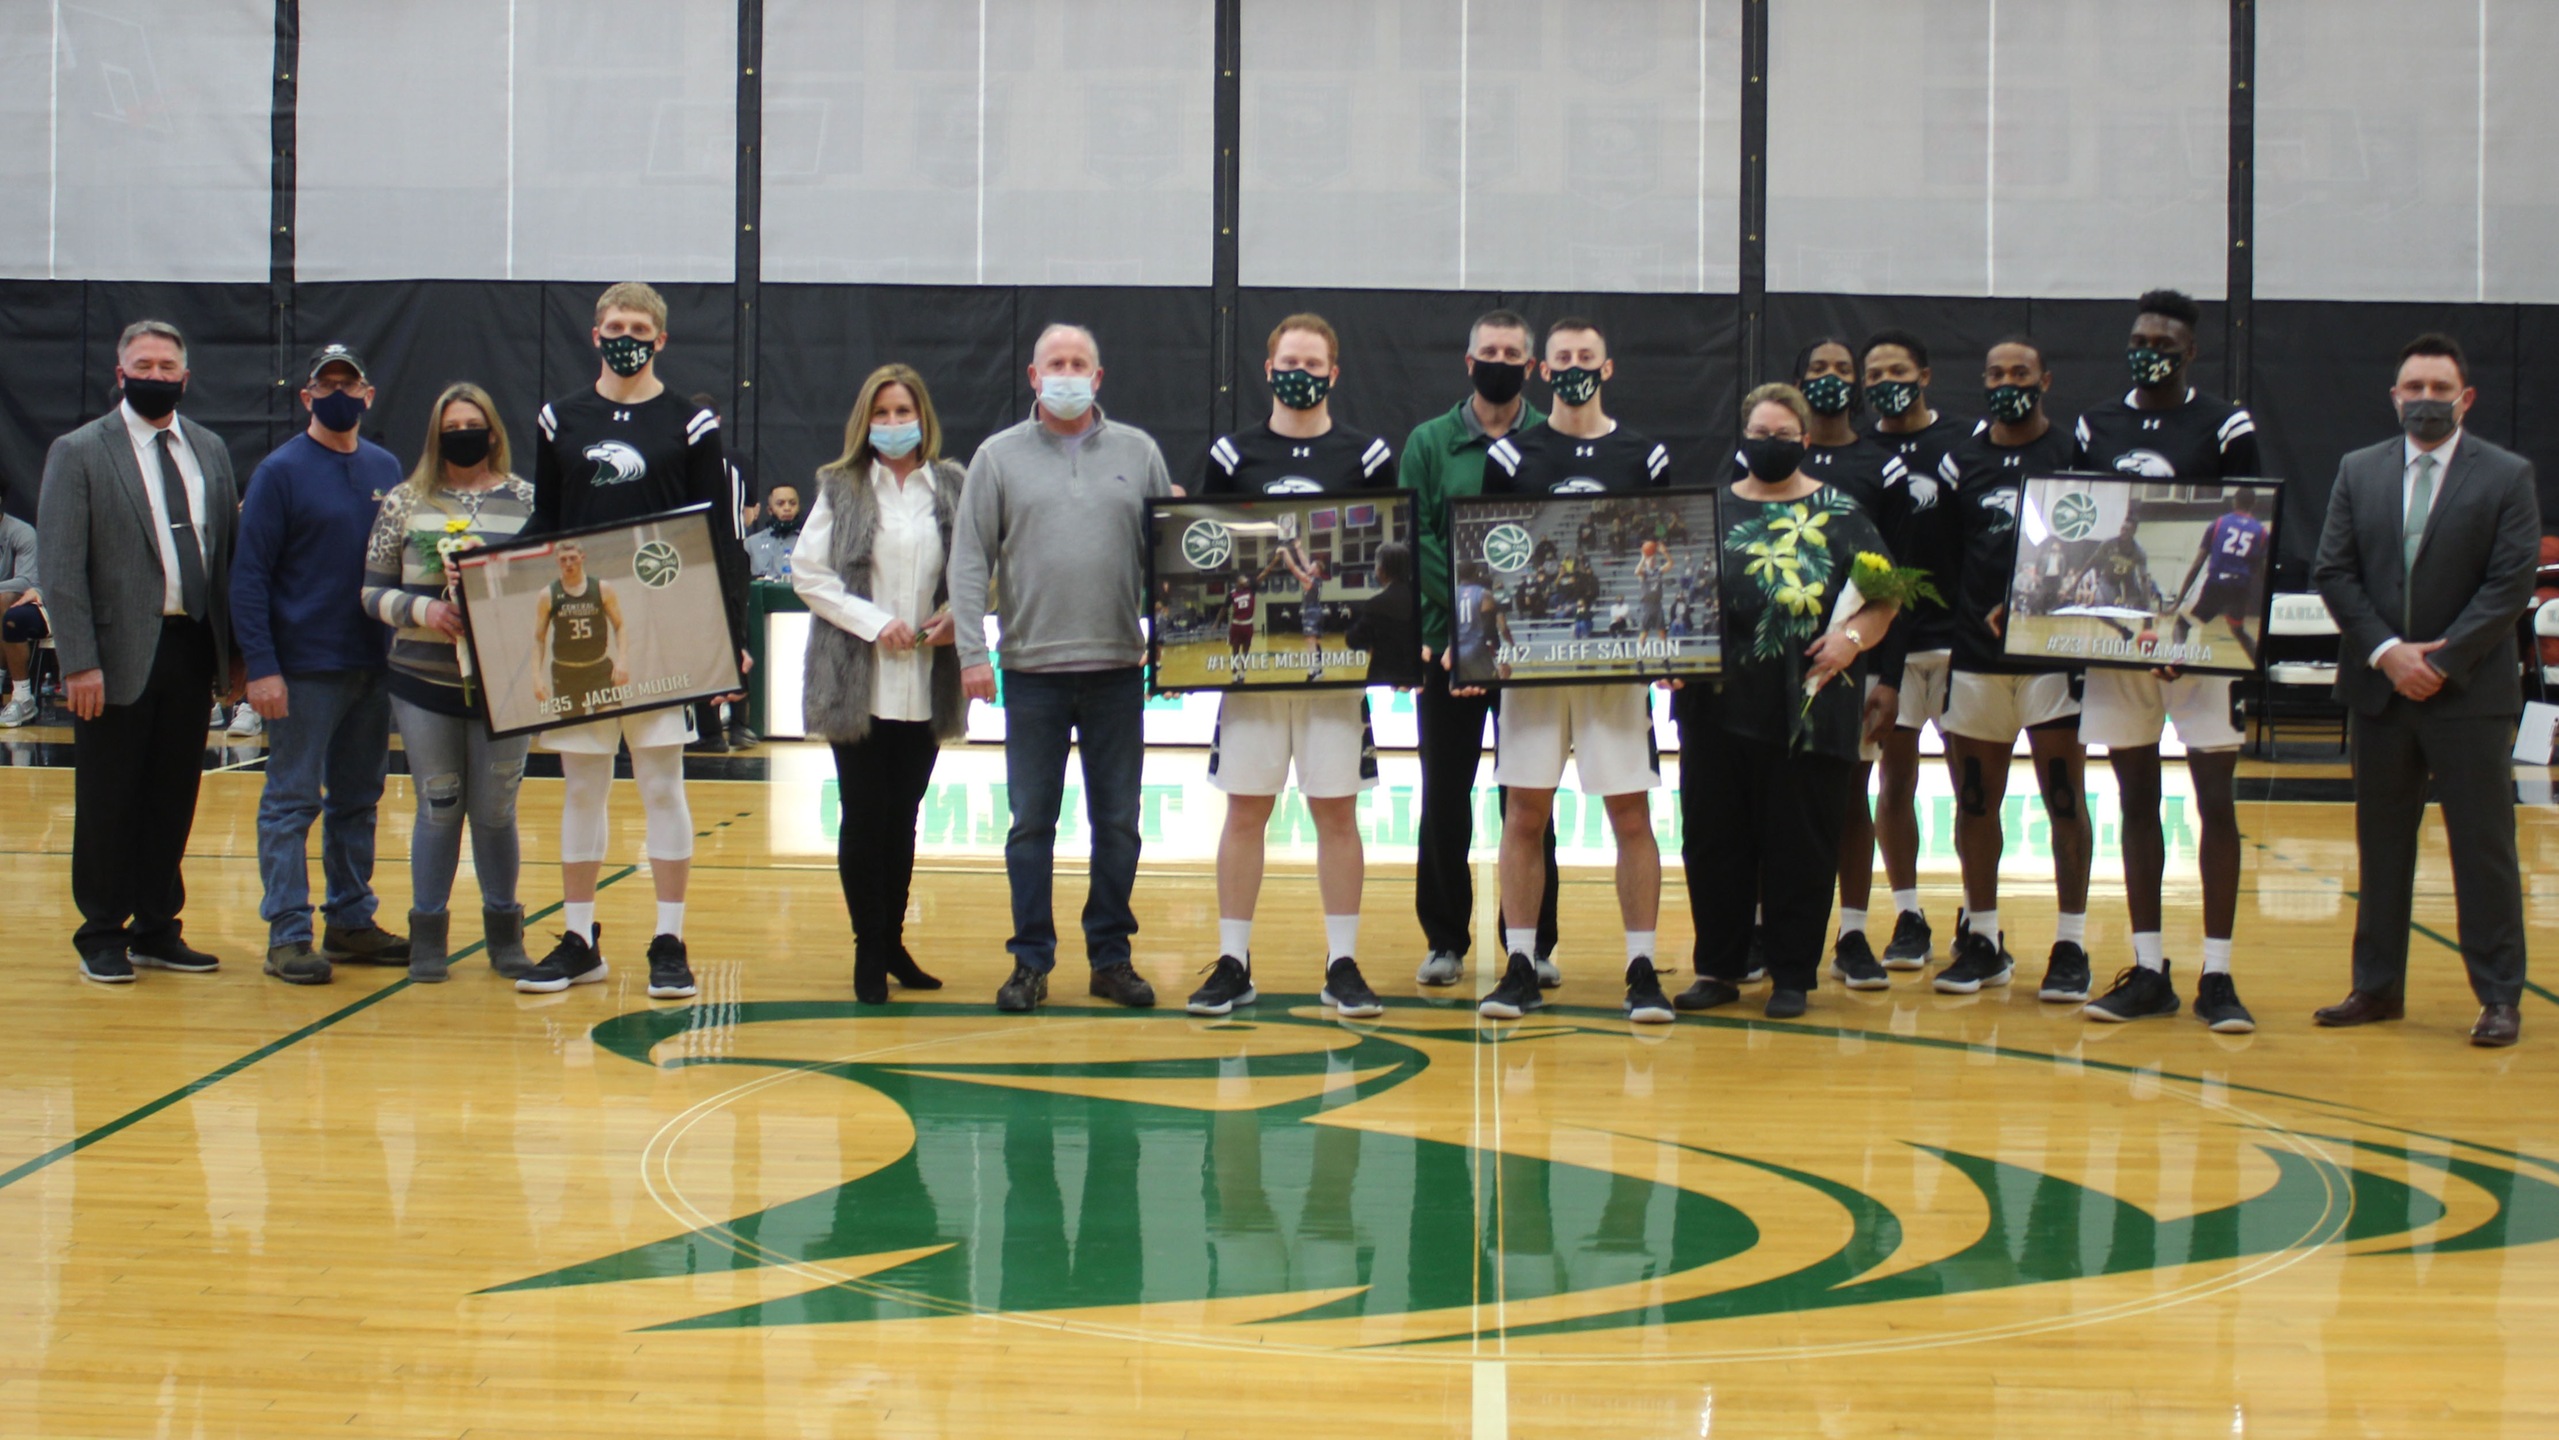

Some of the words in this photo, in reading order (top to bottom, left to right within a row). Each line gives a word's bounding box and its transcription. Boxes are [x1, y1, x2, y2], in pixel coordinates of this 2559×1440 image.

[630, 347, 647, 367] 35
[2148, 359, 2171, 382] 23
[1307, 385, 1315, 403] 1
[1577, 375, 1595, 401] 12
[1839, 387, 1850, 408] 5
[1894, 388, 1911, 412] 15
[2013, 393, 2032, 417] 11
[2222, 526, 2255, 557] 25
[1460, 598, 1472, 624] 11
[569, 618, 592, 640] 35
[1497, 646, 1531, 664] #12
[1544, 642, 1591, 662] JEFF
[1598, 639, 1680, 660] SALMON
[2047, 635, 2081, 656] #23
[2091, 637, 2135, 657] FODE
[2140, 639, 2212, 661] CAMARA
[1207, 655, 1224, 671] #1
[1230, 653, 1269, 670] KYLE
[1275, 650, 1367, 669] MCDERMED
[540, 695, 573, 715] #35
[582, 683, 634, 708] JACOB
[638, 672, 692, 696] MOORE
